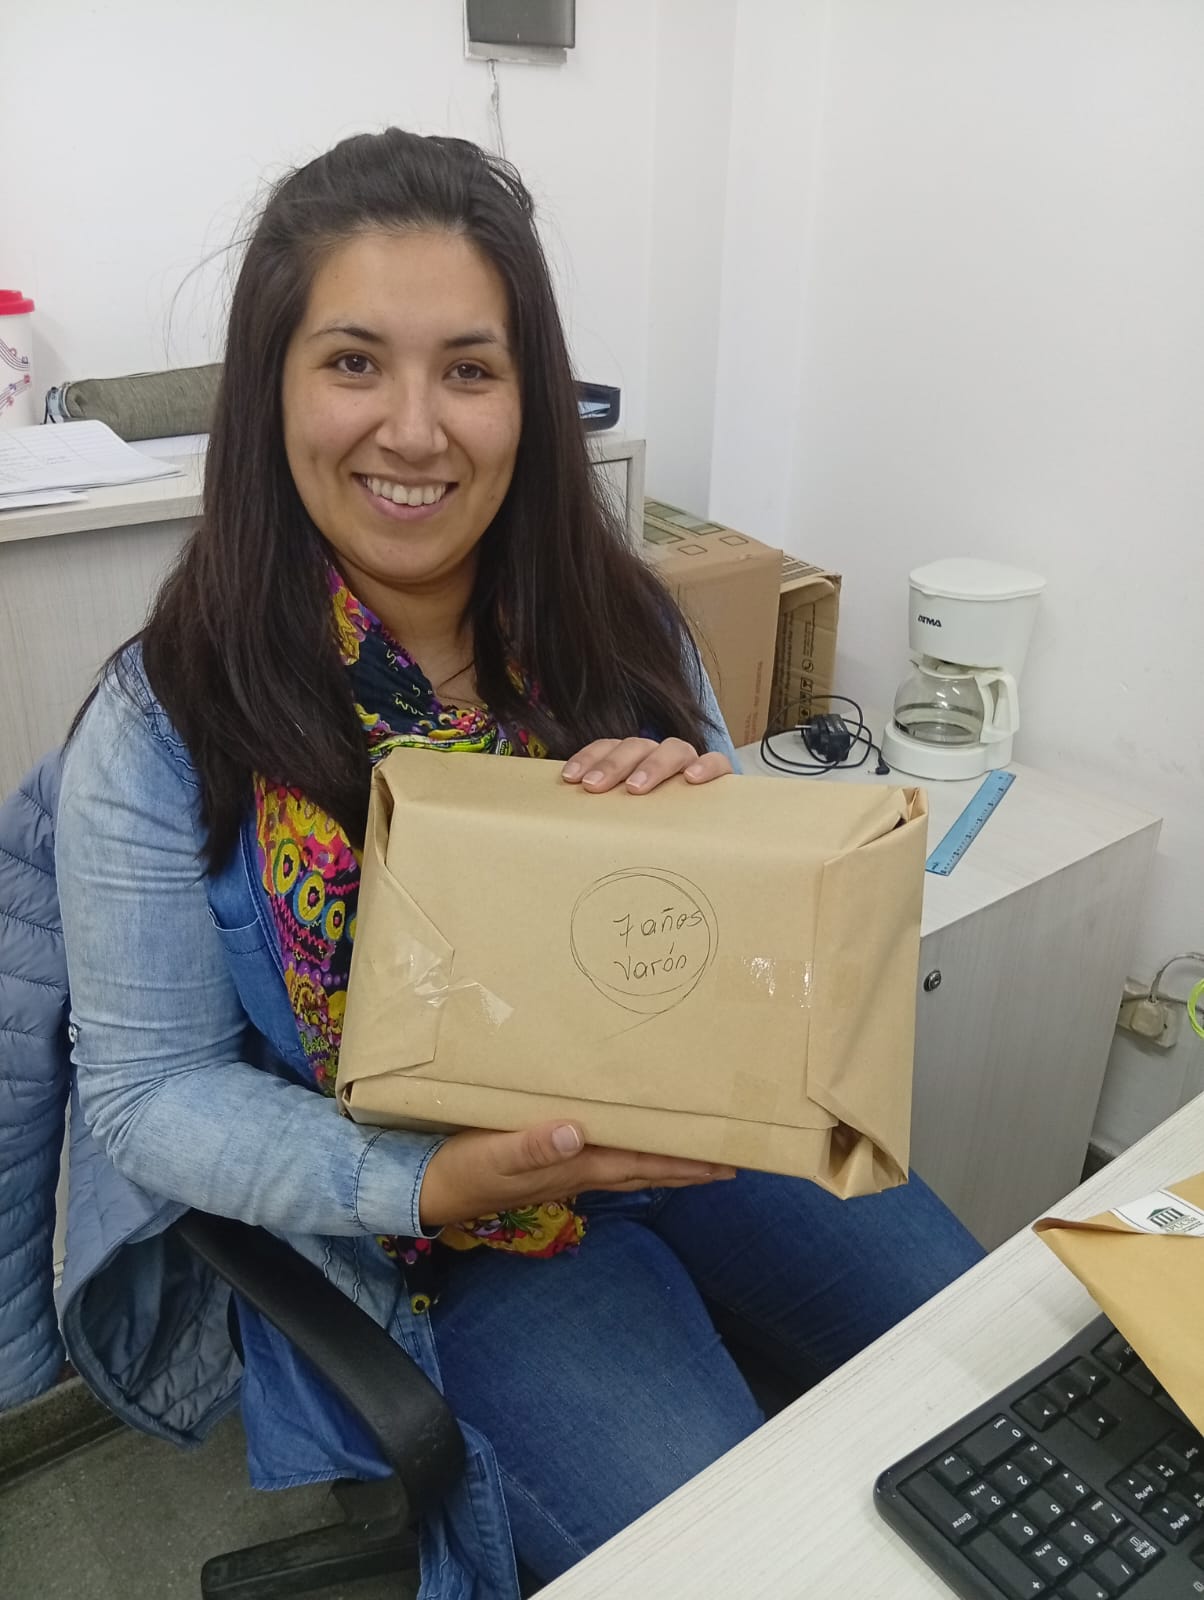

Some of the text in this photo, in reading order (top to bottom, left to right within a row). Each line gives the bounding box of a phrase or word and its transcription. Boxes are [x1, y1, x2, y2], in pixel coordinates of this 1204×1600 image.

[613, 907, 702, 948] 7 años
[1011, 1428, 1021, 1438] 0
[1043, 1456, 1054, 1467] 1
[1016, 1475, 1028, 1486] 2
[1075, 1484, 1086, 1494] 4
[991, 1495, 1001, 1505] 3
[1050, 1504, 1060, 1514] 5
[1111, 1513, 1121, 1524] 7
[1023, 1526, 1034, 1536] 6
[1083, 1534, 1094, 1544] 8
[1057, 1556, 1068, 1567] 9
